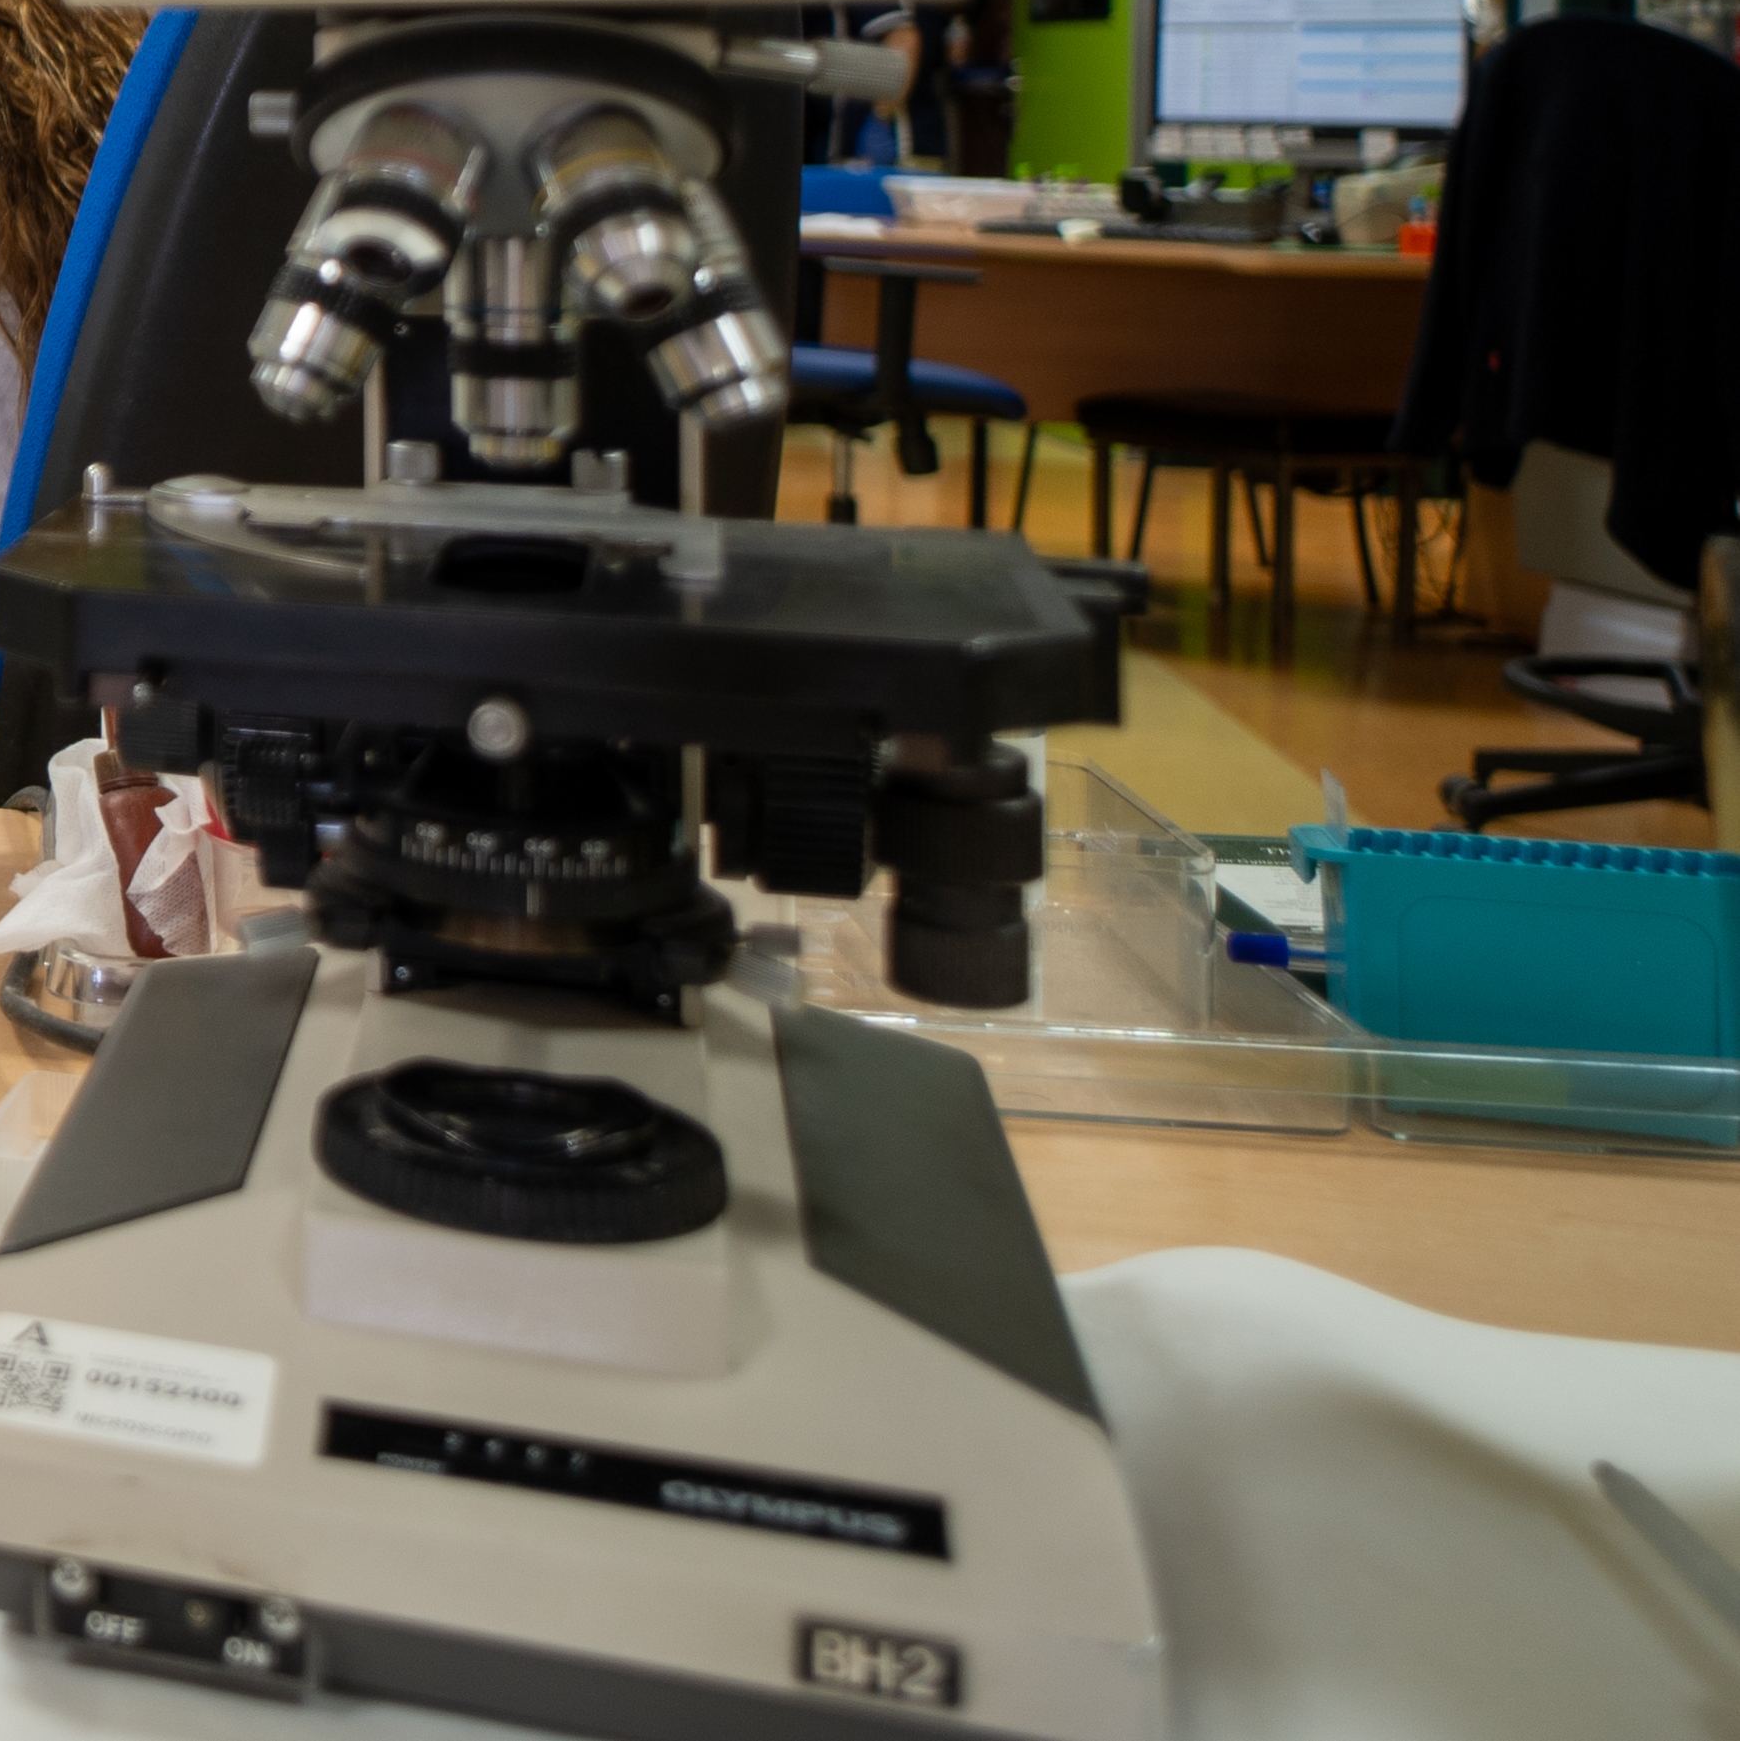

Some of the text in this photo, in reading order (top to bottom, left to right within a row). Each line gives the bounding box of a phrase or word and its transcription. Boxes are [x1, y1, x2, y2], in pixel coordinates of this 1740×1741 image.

[659, 1477, 912, 1546] OLYMPUS
[82, 1608, 273, 1670] OFF ON
